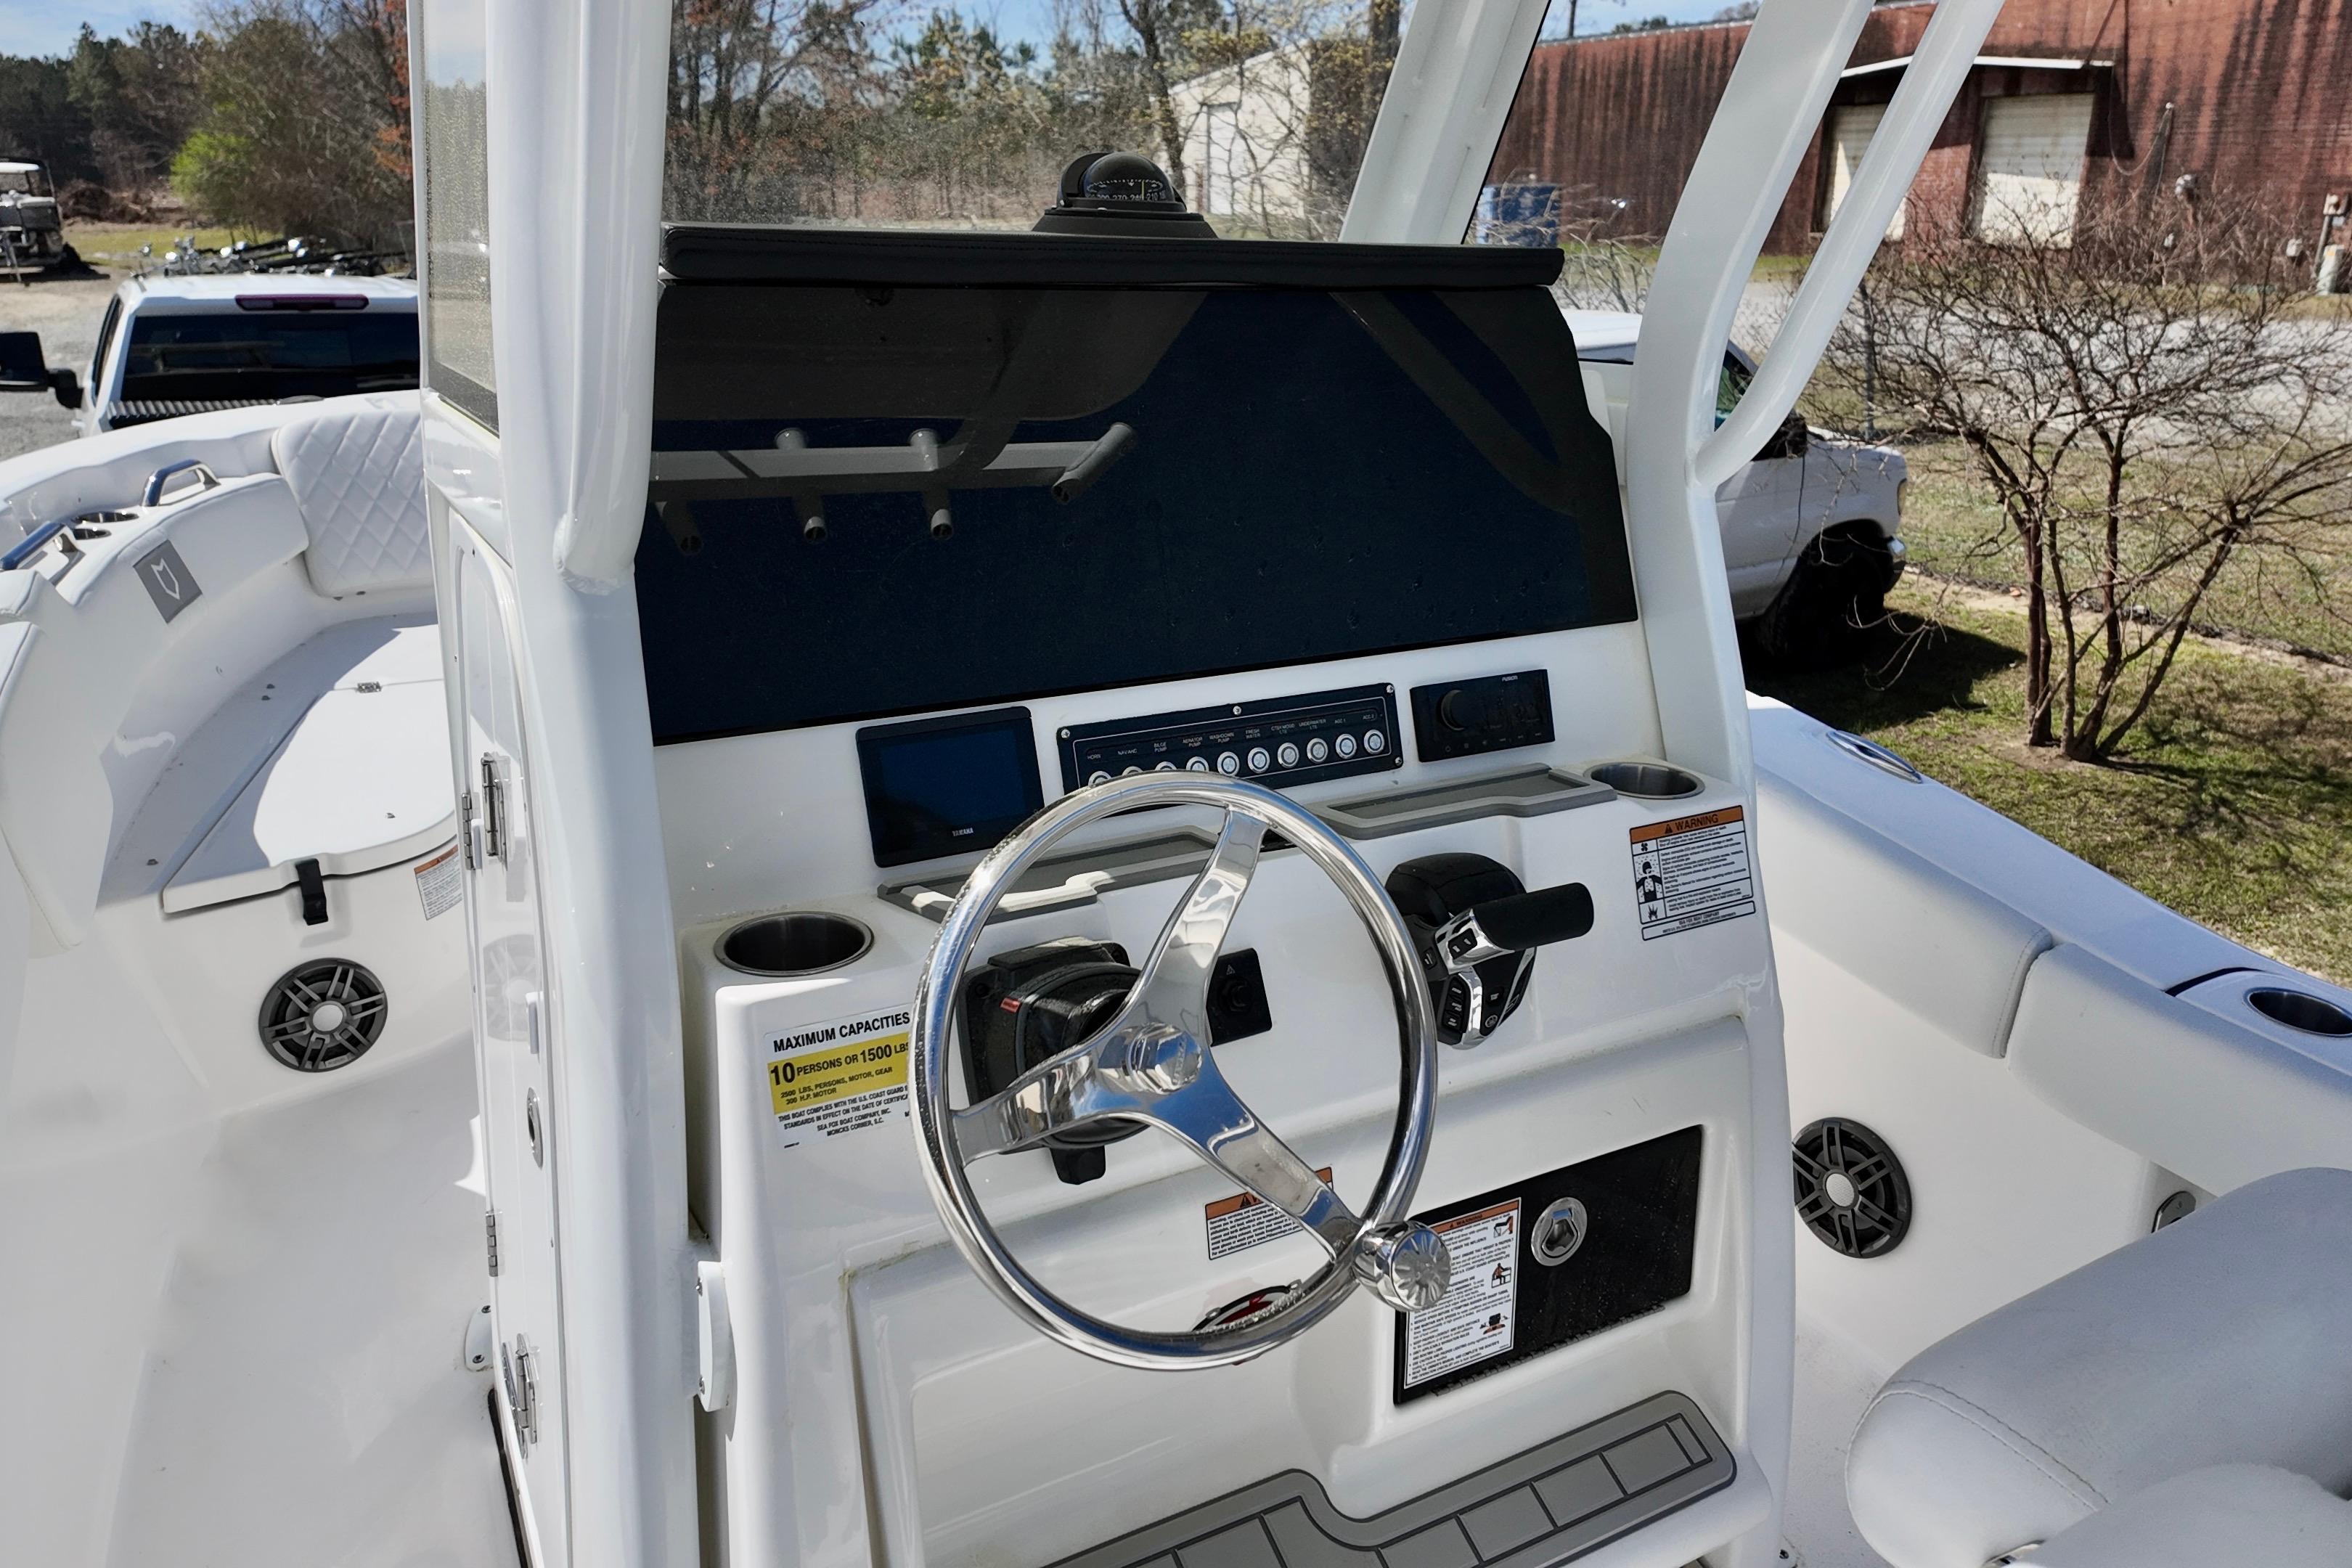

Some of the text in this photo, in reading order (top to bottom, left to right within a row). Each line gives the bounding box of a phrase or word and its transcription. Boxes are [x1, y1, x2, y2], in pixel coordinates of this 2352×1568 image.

[1675, 814, 1719, 831] WARNING
[774, 1012, 910, 1053] MAXIMUM CAPACITIES
[770, 1062, 796, 1086] 10
[797, 1058, 842, 1076] PERSONS
[845, 1054, 858, 1066] OR
[860, 1044, 891, 1063] 1500
[781, 1089, 796, 1099] 2500
[875, 1067, 893, 1076] GEAR
[813, 1087, 836, 1098] MOTOR
[778, 1114, 791, 1122] THIS
[791, 1110, 805, 1119] BOAT
[807, 1103, 833, 1115] COMPLIES
[833, 1100, 846, 1108] WITH
[869, 1090, 886, 1101] COAST
[887, 1086, 904, 1095] GUARD
[784, 1118, 814, 1130] STANDARDS
[822, 1111, 841, 1119] EFFECT
[862, 1101, 875, 1111] DATE
